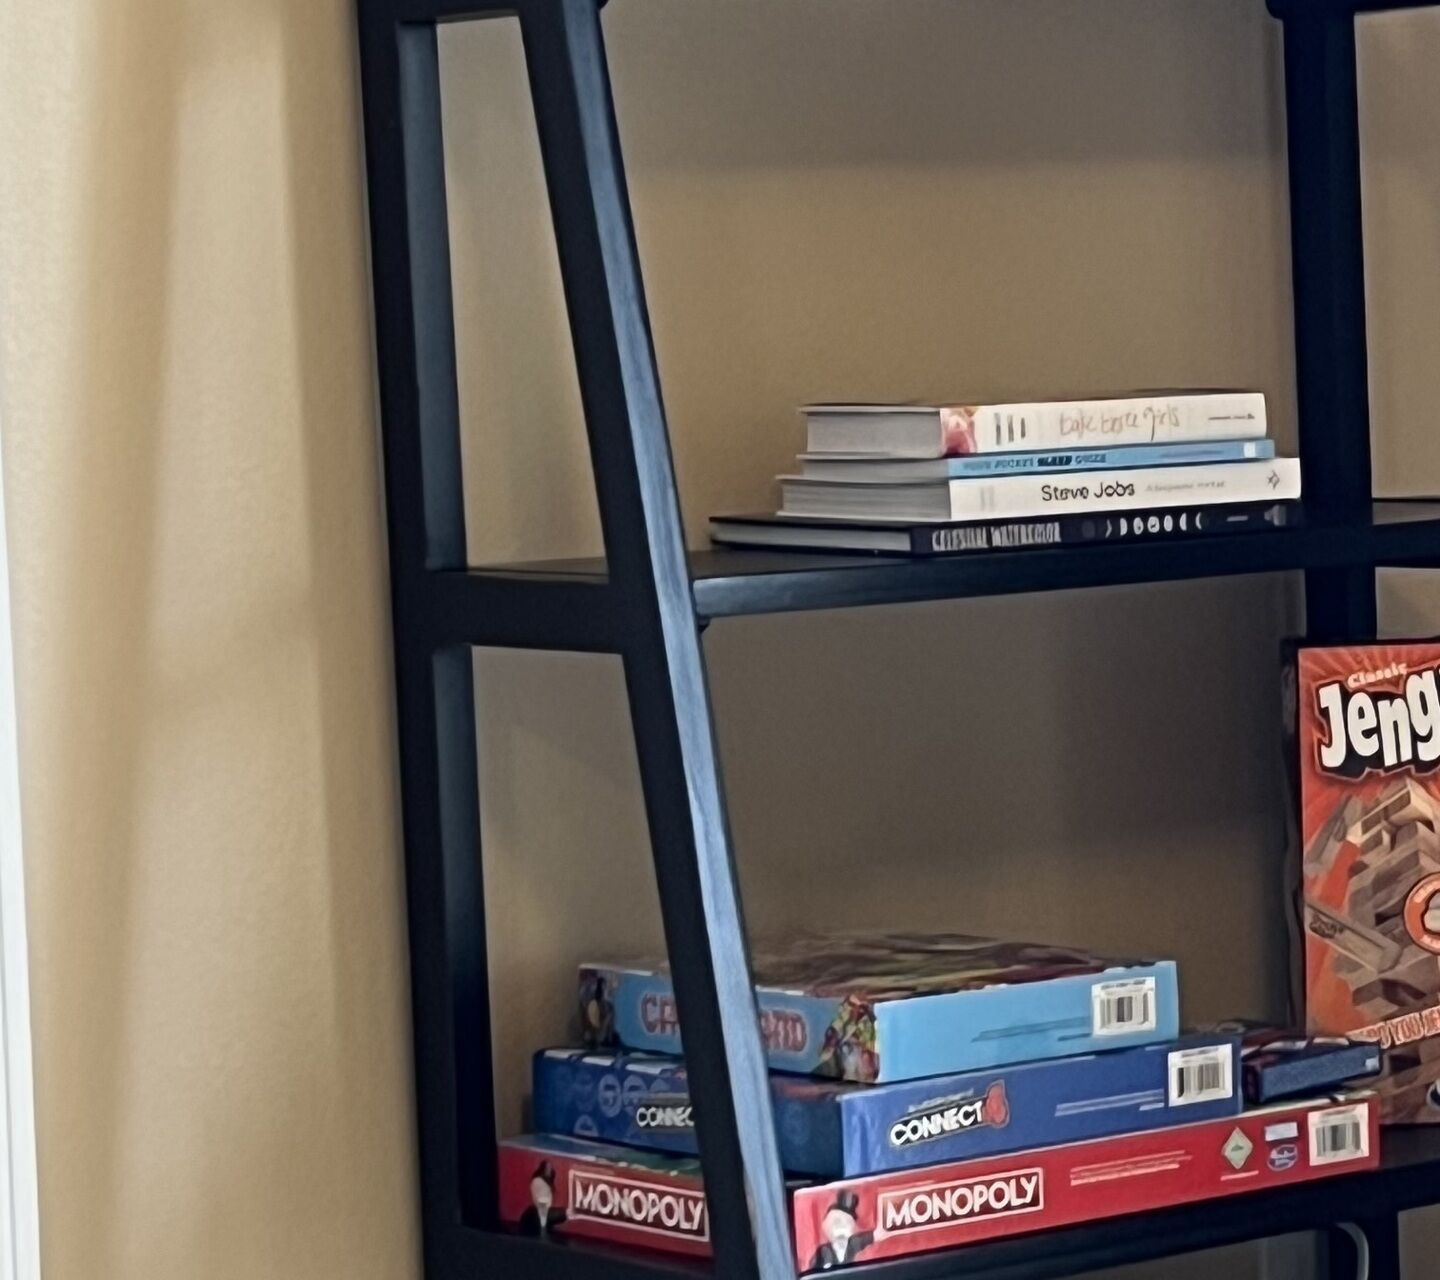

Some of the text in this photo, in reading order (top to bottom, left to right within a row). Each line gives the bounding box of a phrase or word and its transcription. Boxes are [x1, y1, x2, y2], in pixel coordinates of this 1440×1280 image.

[1041, 484, 1089, 502] Steve
[1093, 479, 1136, 499] Jobs
[1347, 661, 1407, 688] Classic
[636, 1106, 695, 1127] CONNEC
[889, 1099, 984, 1146] CONNECT
[575, 1179, 704, 1231] MONOPOLY
[885, 1174, 1039, 1229] MONOPOLY
